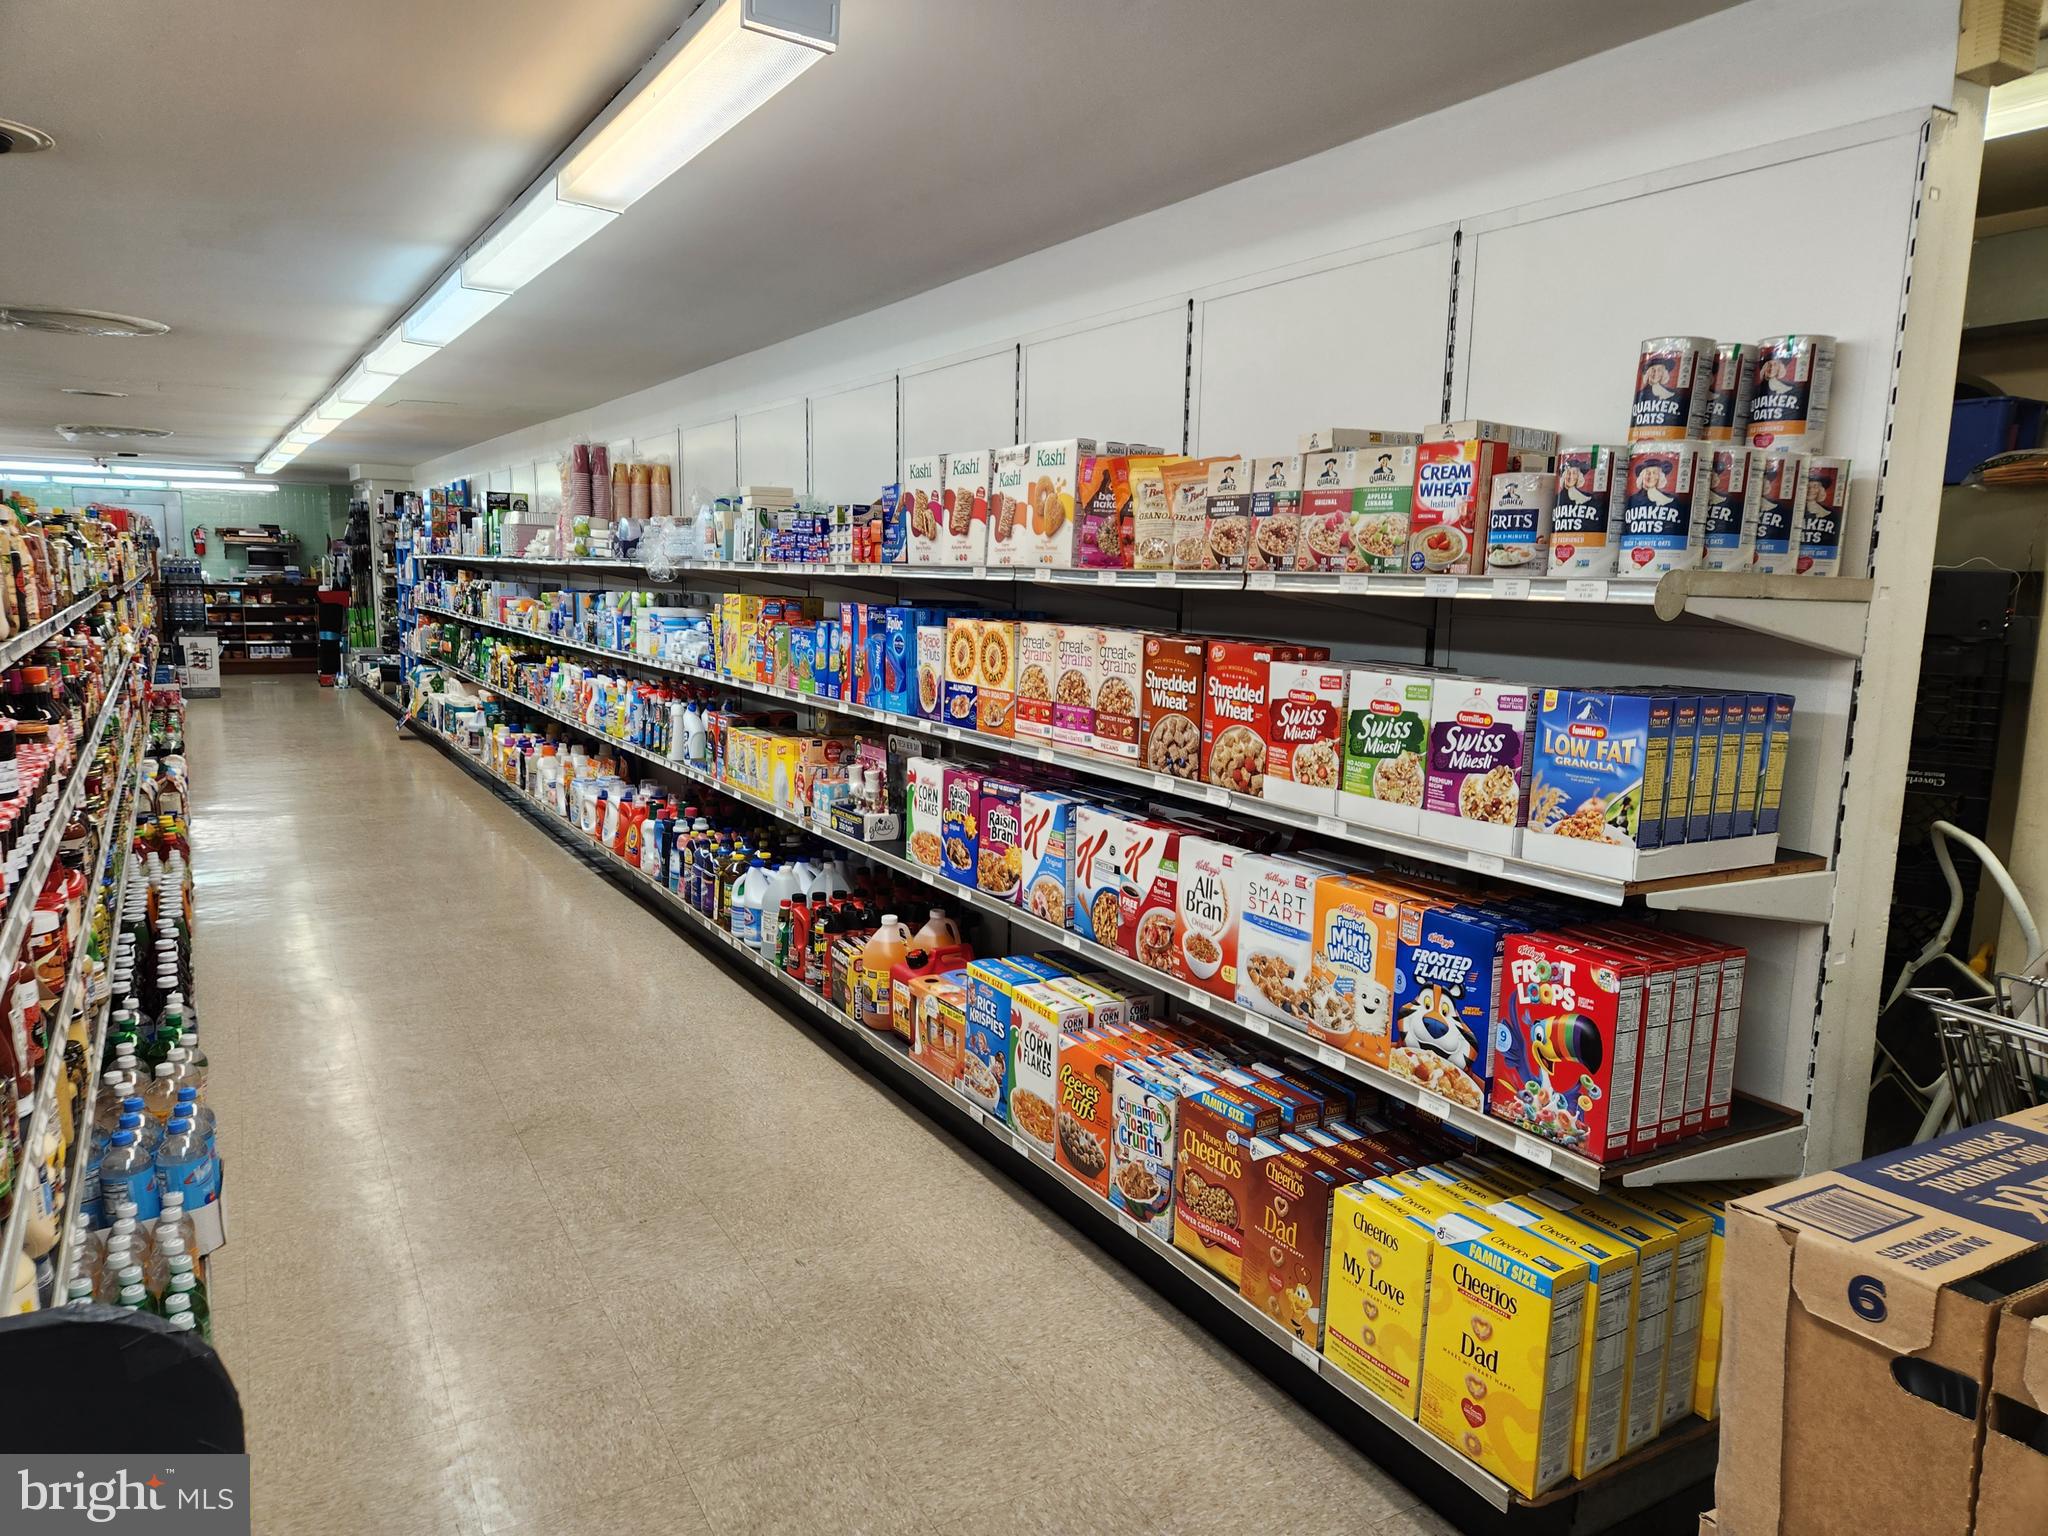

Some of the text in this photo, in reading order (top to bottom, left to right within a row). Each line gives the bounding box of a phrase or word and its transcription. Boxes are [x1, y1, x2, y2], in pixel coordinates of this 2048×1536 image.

[1633, 400, 1679, 417] QUAKER
[1754, 407, 1782, 421] OATS
[1636, 413, 1664, 425] OATS
[953, 457, 979, 476] Kashi
[1036, 448, 1066, 467] Kashi
[910, 462, 932, 479] Kashi
[1000, 469, 1022, 488] Kashi
[1369, 474, 1395, 484] QUAKER
[1421, 464, 1471, 481] CREAM
[1265, 480, 1287, 489] QUAKER
[1317, 479, 1340, 487] QUAKER
[1420, 482, 1471, 498] WHEAT
[1430, 499, 1456, 508] Instant
[1491, 513, 1533, 529] GRITS
[1626, 505, 1677, 523] QUAKER
[1555, 518, 1582, 531] OATS
[1631, 521, 1663, 533] OATS
[1022, 637, 1045, 652] great
[1059, 640, 1084, 656] great
[1100, 645, 1127, 662] great
[1024, 650, 1052, 665] grains
[1061, 653, 1092, 670] grains
[1102, 659, 1137, 676] grains
[1146, 669, 1196, 694] Shredded
[1208, 676, 1264, 704] Shredded
[1151, 688, 1188, 711] Wheat
[1290, 691, 1310, 701] familia
[1214, 697, 1254, 722] Wheat
[1277, 703, 1326, 727] Swiss
[1373, 703, 1394, 712] familia
[1357, 714, 1412, 740] Swiss
[1459, 713, 1484, 724] familia
[1283, 725, 1317, 741] Müesli
[1441, 726, 1505, 753] Swiss
[1572, 726, 1596, 737] familia
[1364, 738, 1401, 754] Müesli
[1544, 728, 1636, 763] LOW FAT
[1449, 751, 1492, 770] Müesli
[1555, 756, 1615, 772] GRANOLA
[1429, 776, 1453, 785] PREMIUM
[920, 785, 938, 803] CORN
[949, 786, 970, 806] Raisin
[919, 802, 938, 817] FLAKES
[951, 800, 967, 814] Bran
[869, 821, 894, 840] glade
[989, 811, 1017, 833] Raisin
[992, 826, 1014, 843] Bran
[1024, 808, 1050, 860] K
[1077, 829, 1108, 889] K
[1124, 837, 1153, 883] K
[1154, 887, 1171, 898] Berries
[1249, 882, 1306, 910] SMART
[1122, 897, 1138, 909] FREE
[1186, 890, 1222, 922] Bran
[1248, 896, 1306, 925] START
[1192, 917, 1214, 931] Original
[1338, 916, 1364, 933] Frosted
[1332, 927, 1370, 953] Mini
[1428, 932, 1454, 948] Kellogg's
[1329, 943, 1370, 973] Wheats
[1412, 948, 1472, 971] FROSTED
[1518, 944, 1546, 961] Kellogg's
[1414, 963, 1466, 984] FLAKES
[1511, 959, 1576, 986] FROOT
[977, 996, 997, 1018] RICE
[1017, 993, 1051, 1019] FAMILY SIZE
[1517, 983, 1576, 1011] LOOPS
[970, 1008, 1005, 1039] KRISPIES
[1063, 1018, 1084, 1029] CORN
[1025, 1031, 1052, 1061] CORN
[1500, 1031, 1507, 1041] 9
[1024, 1049, 1052, 1077] FLAKES
[1060, 1064, 1101, 1103] Reese's
[1062, 1087, 1096, 1121] Puffs
[1119, 1095, 1163, 1124] Cinnamon
[1202, 1093, 1244, 1124] FAMILY SIZE
[1126, 1113, 1154, 1137] Toast
[1120, 1125, 1162, 1157] Crunch
[1203, 1130, 1239, 1156] Honey Nut
[1184, 1128, 1242, 1179] Cheerios
[1876, 1132, 2026, 1182] SPRING WATER
[1266, 1161, 1305, 1198] Cheerios
[1917, 1158, 2021, 1194] NATURAL
[1401, 1195, 1432, 1215] Cheerios
[1178, 1207, 1241, 1248] LOWER CHOLESTEROL
[1264, 1205, 1298, 1249] Dad
[1581, 1208, 1619, 1229] Cheerios
[1353, 1211, 1399, 1252] Cheerios
[1539, 1223, 1578, 1246] Cheerios
[1490, 1235, 1529, 1258] Cheerios
[1876, 1227, 1962, 1259] STACK PALLETS
[1469, 1245, 1537, 1289] FAMILY SIZE
[1903, 1250, 1958, 1270] DOUBLE
[1343, 1252, 1405, 1306] My Love
[1453, 1263, 1518, 1315] Cheerios
[1847, 1274, 1888, 1323] 6
[1461, 1332, 1499, 1374] Dad
[1371, 1356, 1386, 1372] HEART
[1495, 1377, 1516, 1393] HAPPY
